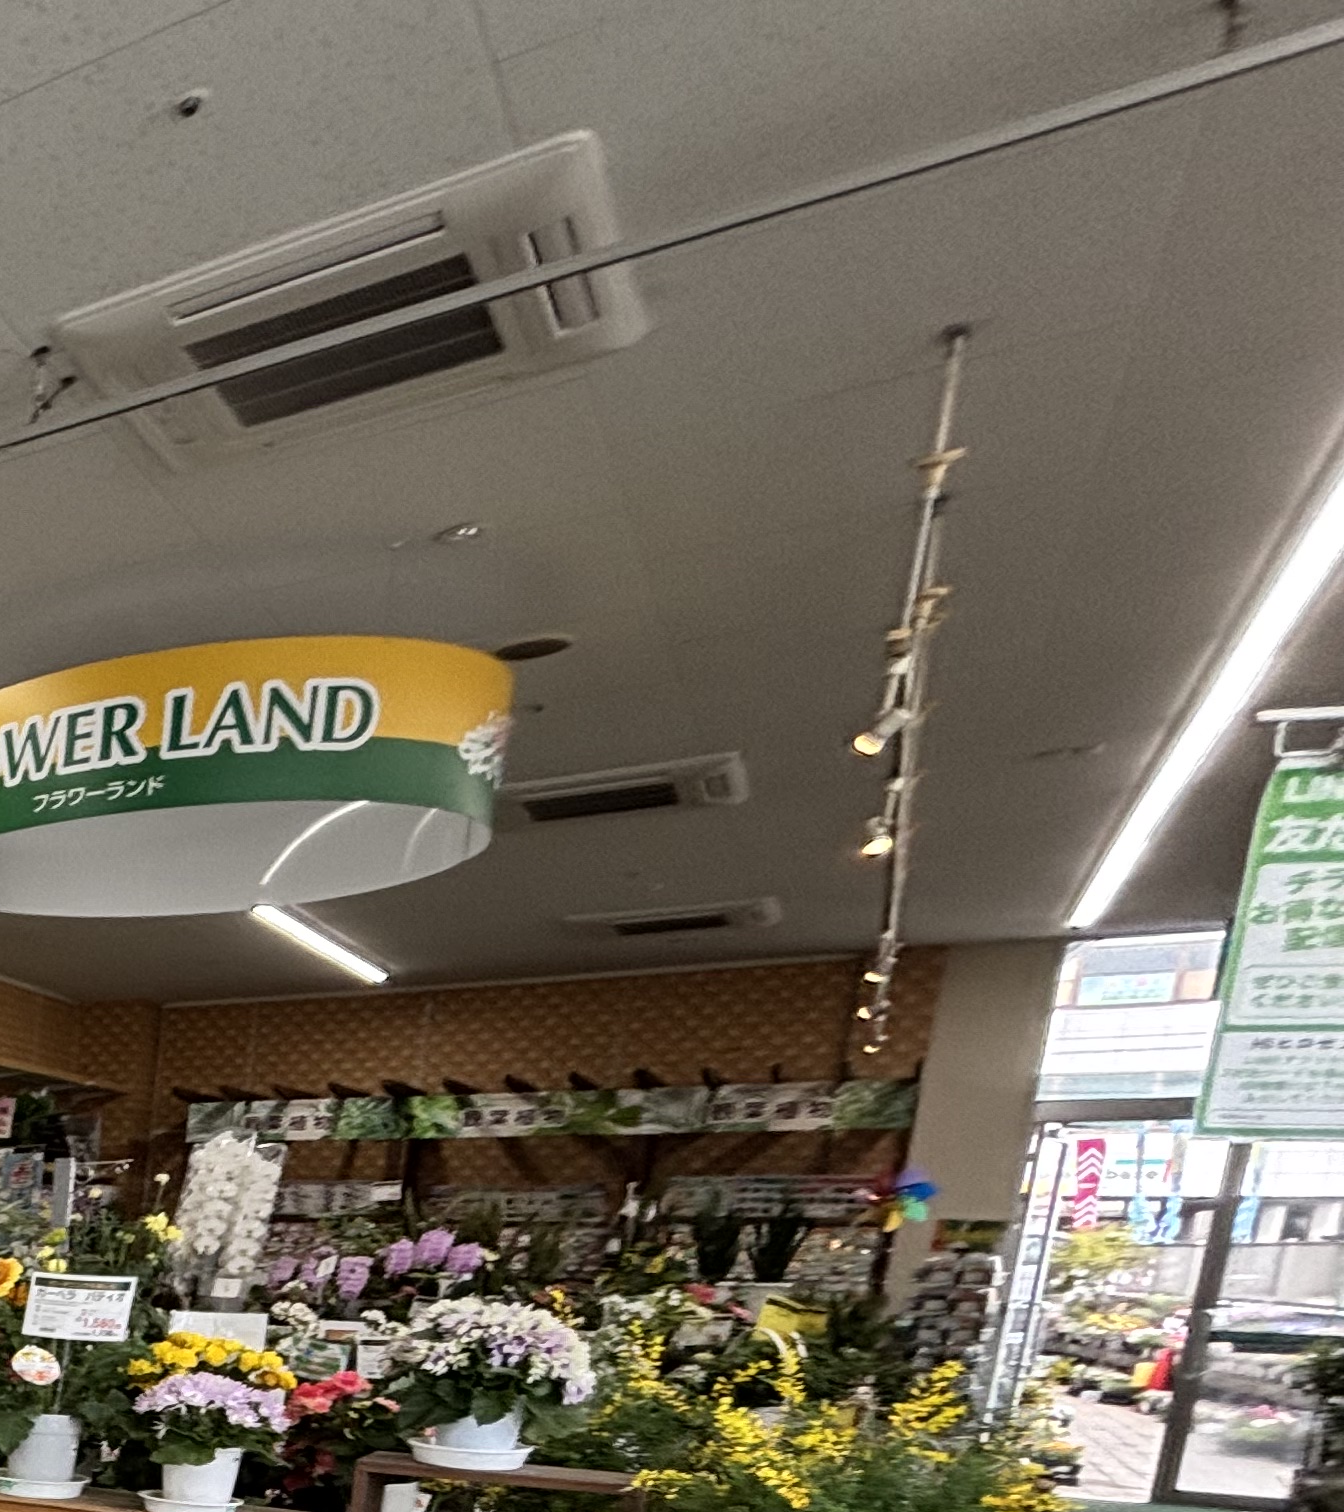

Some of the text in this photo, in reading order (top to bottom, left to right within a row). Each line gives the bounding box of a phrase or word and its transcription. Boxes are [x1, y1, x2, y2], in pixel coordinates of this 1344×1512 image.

[160, 677, 379, 759] LAND
[31, 775, 165, 814] フラワーランド
